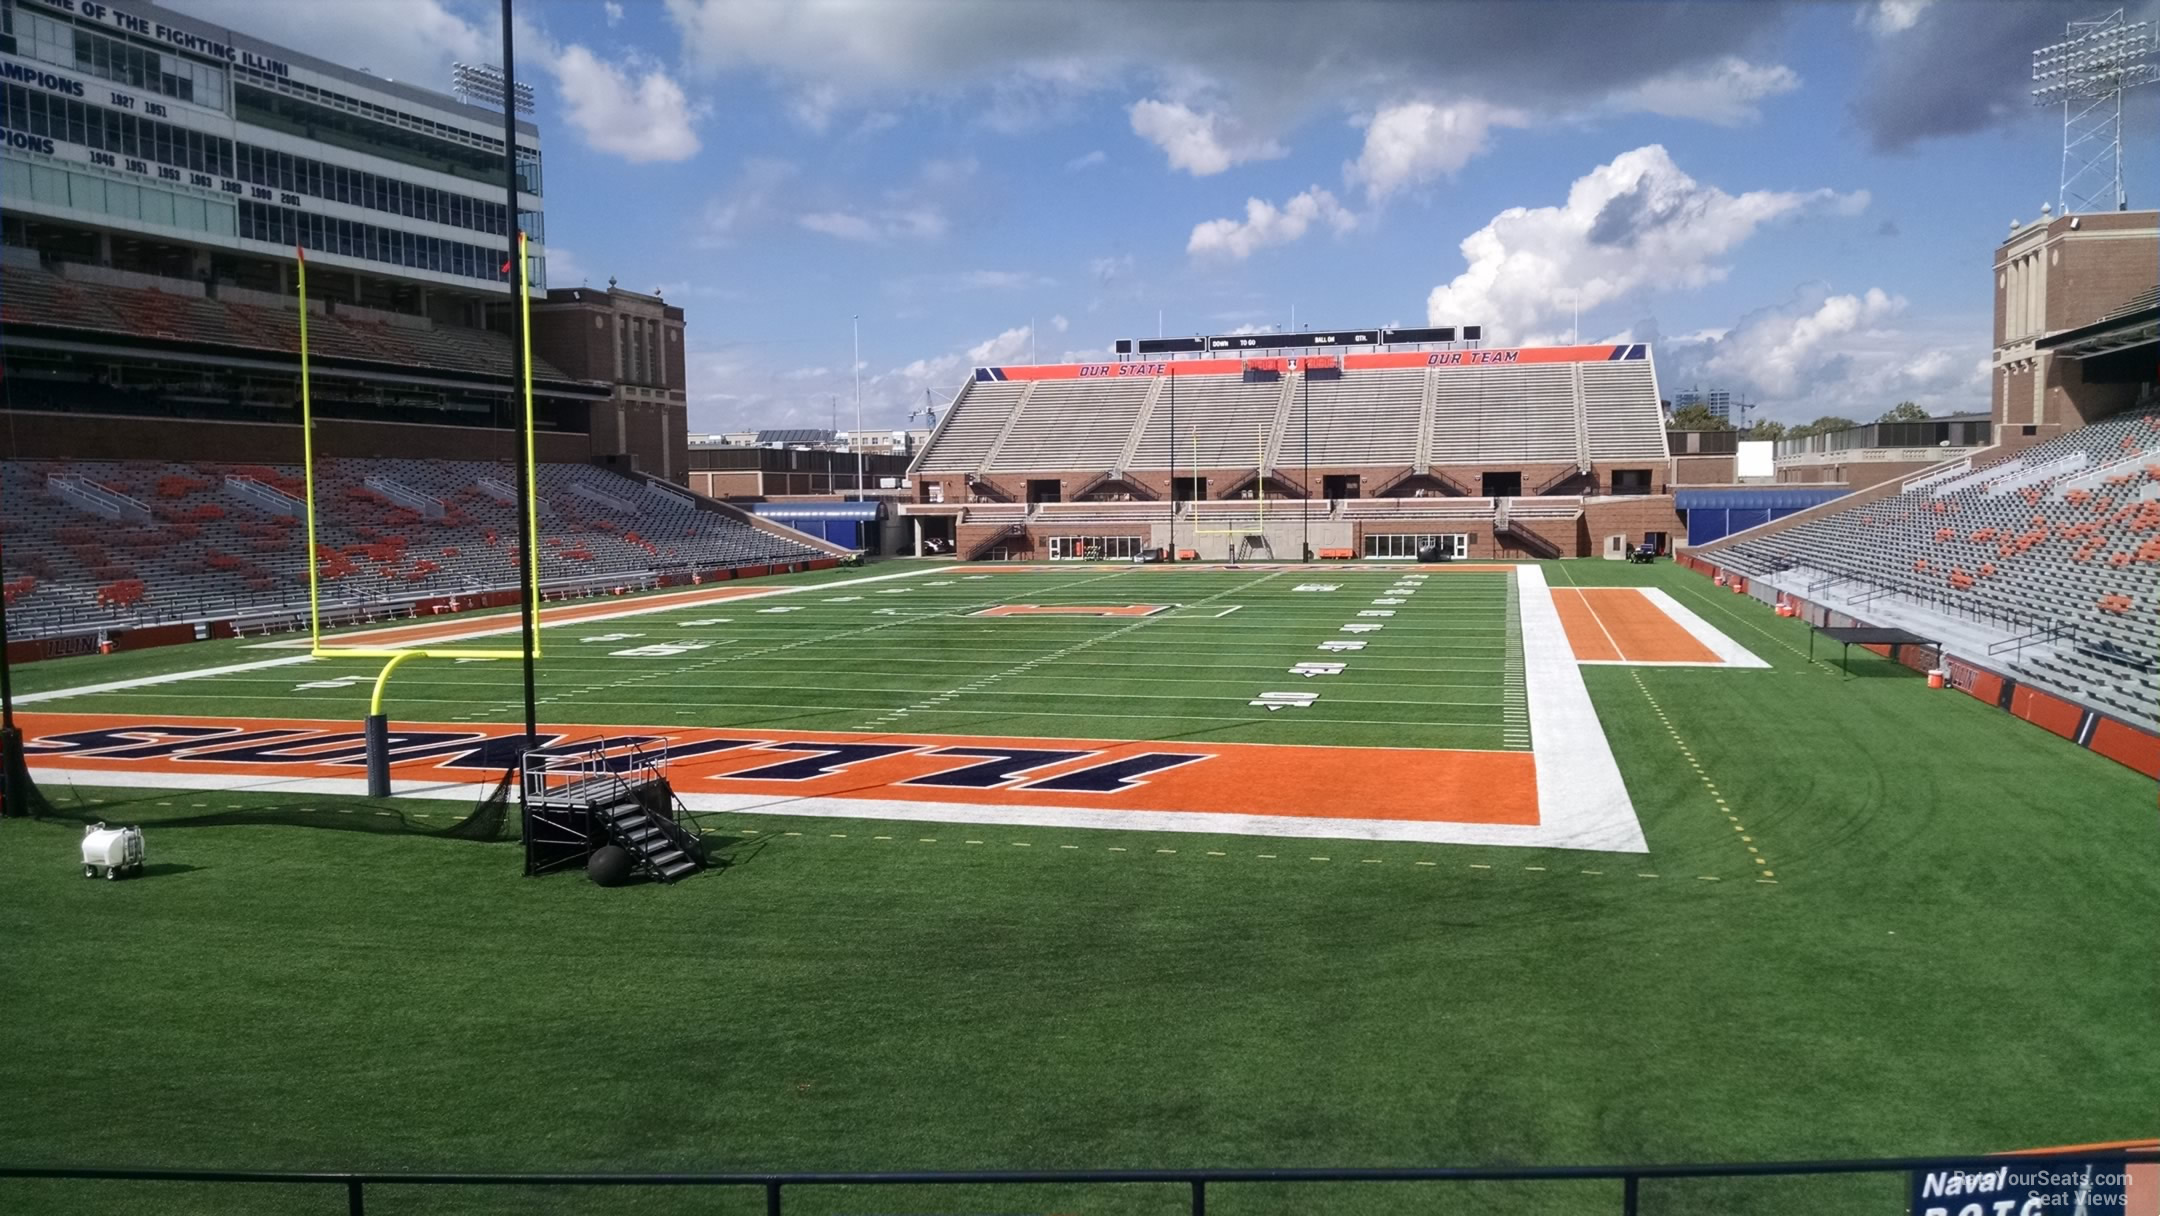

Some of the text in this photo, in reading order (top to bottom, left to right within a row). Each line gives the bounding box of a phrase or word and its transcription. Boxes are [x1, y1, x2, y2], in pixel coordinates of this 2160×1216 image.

[82, 2, 106, 20] OF
[113, 10, 150, 35] THE
[156, 25, 237, 61] FIGHTING
[242, 47, 289, 77] ILLINI
[111, 92, 134, 109] 1927
[1212, 340, 1229, 348] DOWN
[1428, 350, 1520, 366] OUR TEAM
[1079, 363, 1168, 377] OUR STATE
[1922, 1166, 2008, 1199] Naval
